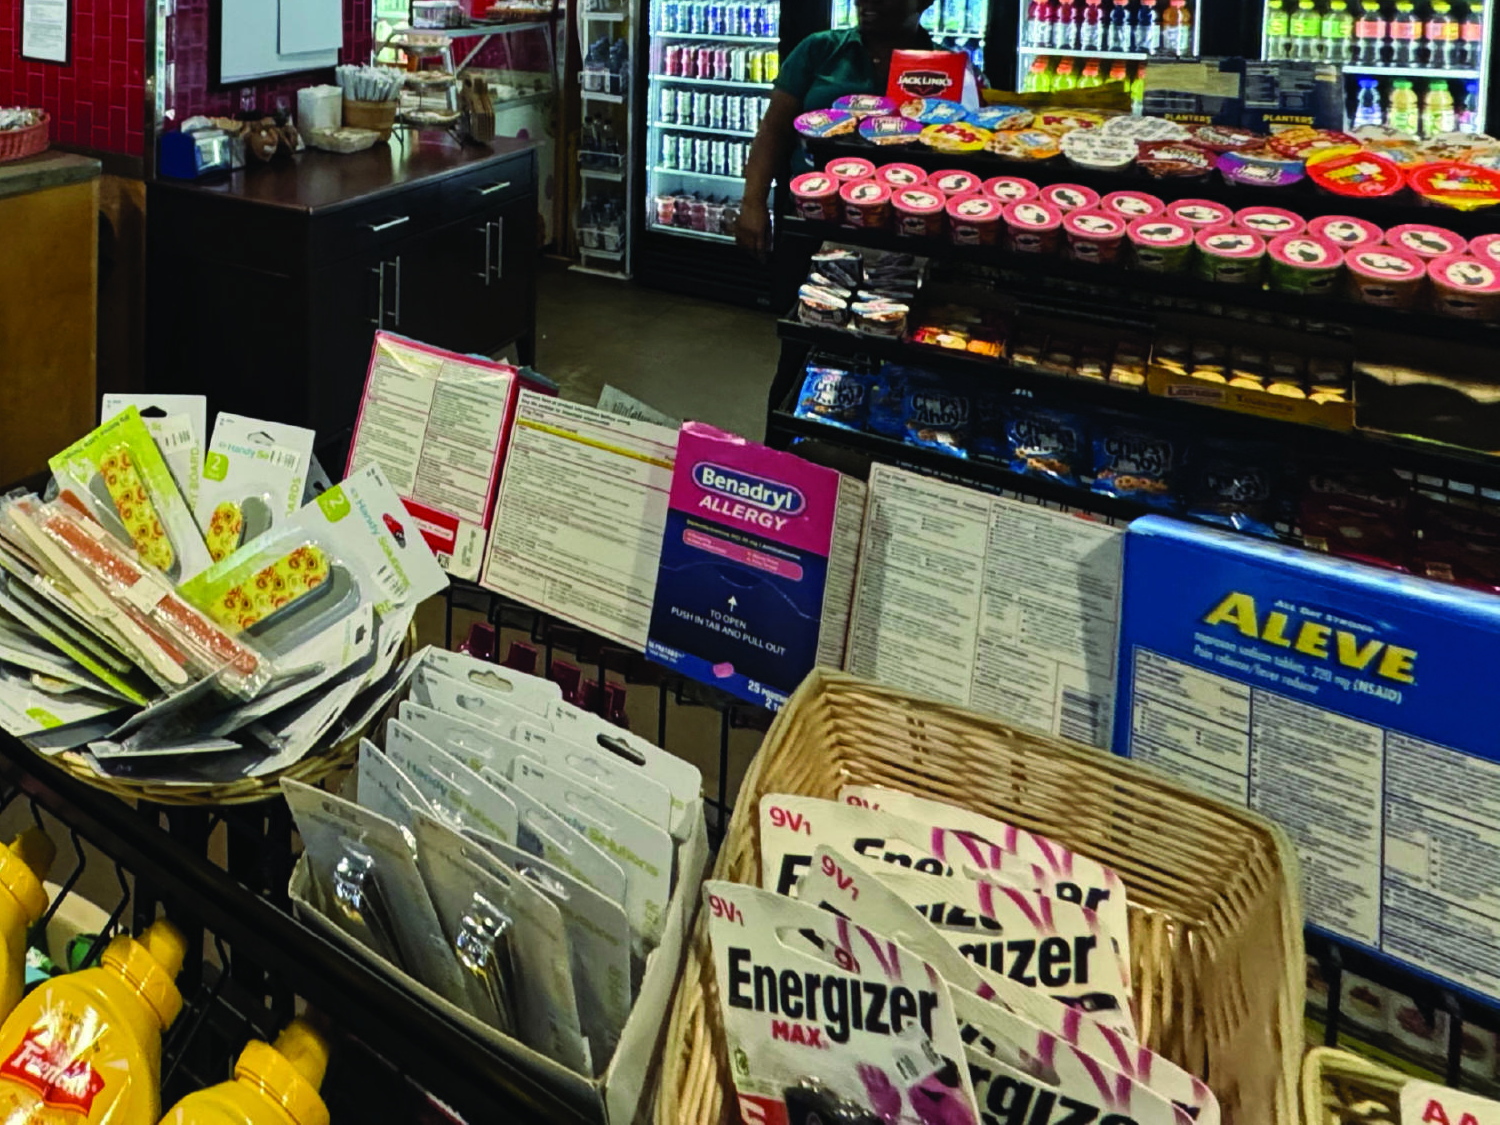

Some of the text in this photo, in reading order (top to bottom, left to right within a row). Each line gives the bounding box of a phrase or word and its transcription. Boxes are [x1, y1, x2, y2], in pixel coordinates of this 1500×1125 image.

[1164, 113, 1213, 125] PLANTERS
[1262, 113, 1315, 126] PLANTERS
[211, 456, 220, 471] 2
[227, 444, 256, 459] Handy
[327, 488, 345, 512] 2
[701, 466, 793, 511] Benadryl
[356, 498, 380, 536] Handy
[698, 494, 788, 532] ALLERGY
[670, 606, 786, 656] PUSH IN TAB AND PULL OUT
[710, 609, 747, 630] TO OPEN
[1203, 590, 1419, 684] ALEVE
[747, 679, 761, 694] 25
[1352, 678, 1403, 705] (NSAID)
[765, 698, 772, 708] 2
[727, 946, 939, 1045] Energizer
[771, 1019, 822, 1049] MAX
